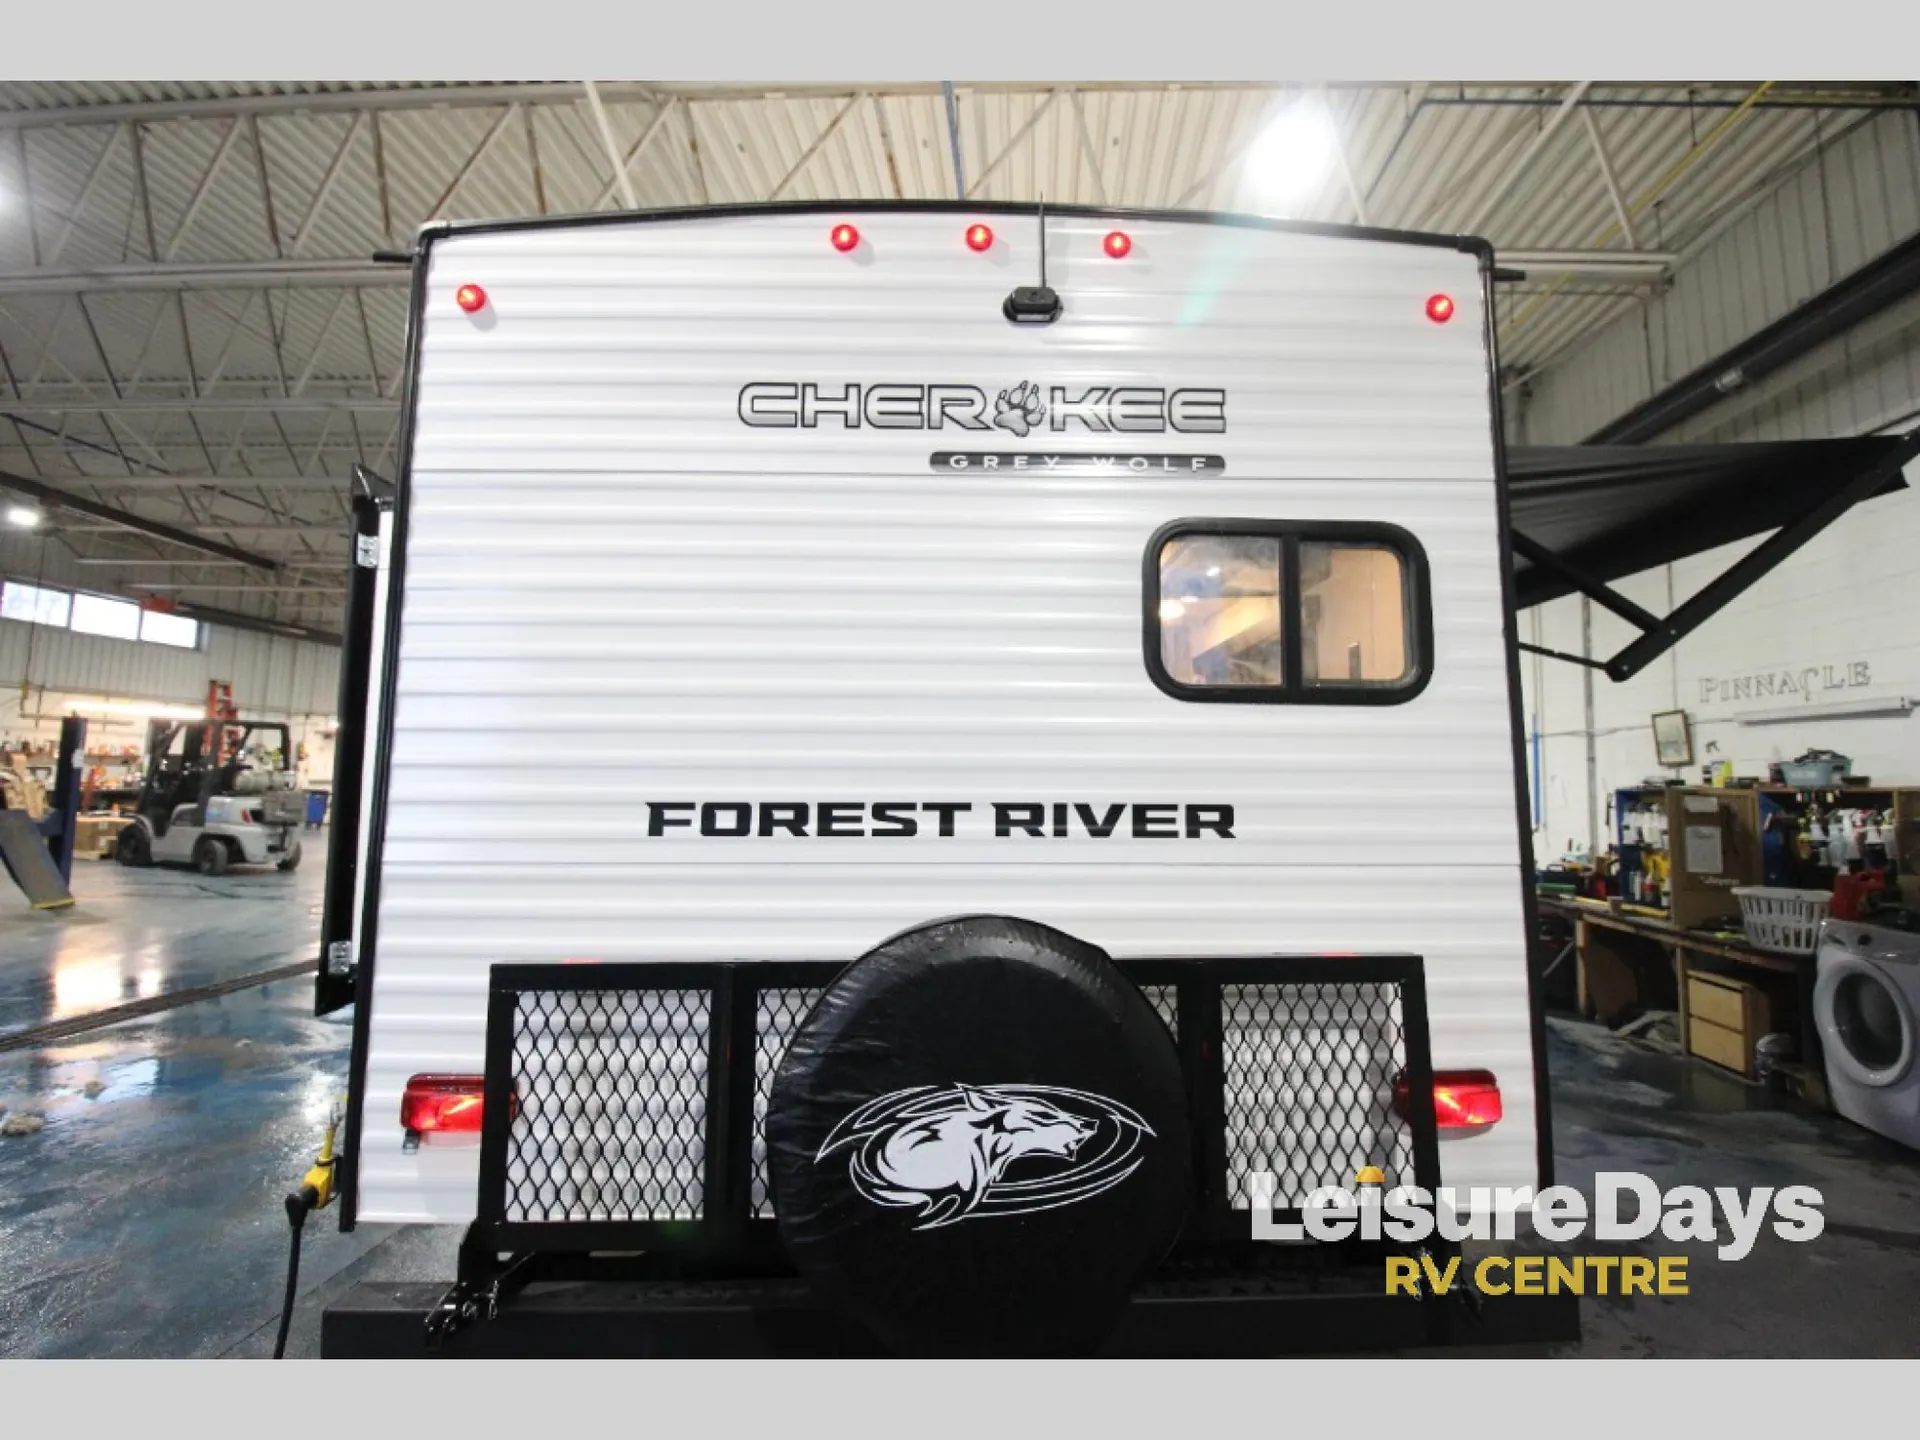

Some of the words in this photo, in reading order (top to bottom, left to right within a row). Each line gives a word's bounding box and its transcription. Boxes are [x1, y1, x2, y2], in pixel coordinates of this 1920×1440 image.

[949, 454, 1060, 470] GREY
[1092, 456, 1207, 472] WOLF
[1699, 661, 1872, 703] PINNACLE
[646, 802, 972, 837] FOREST
[990, 803, 1236, 839] RIVER
